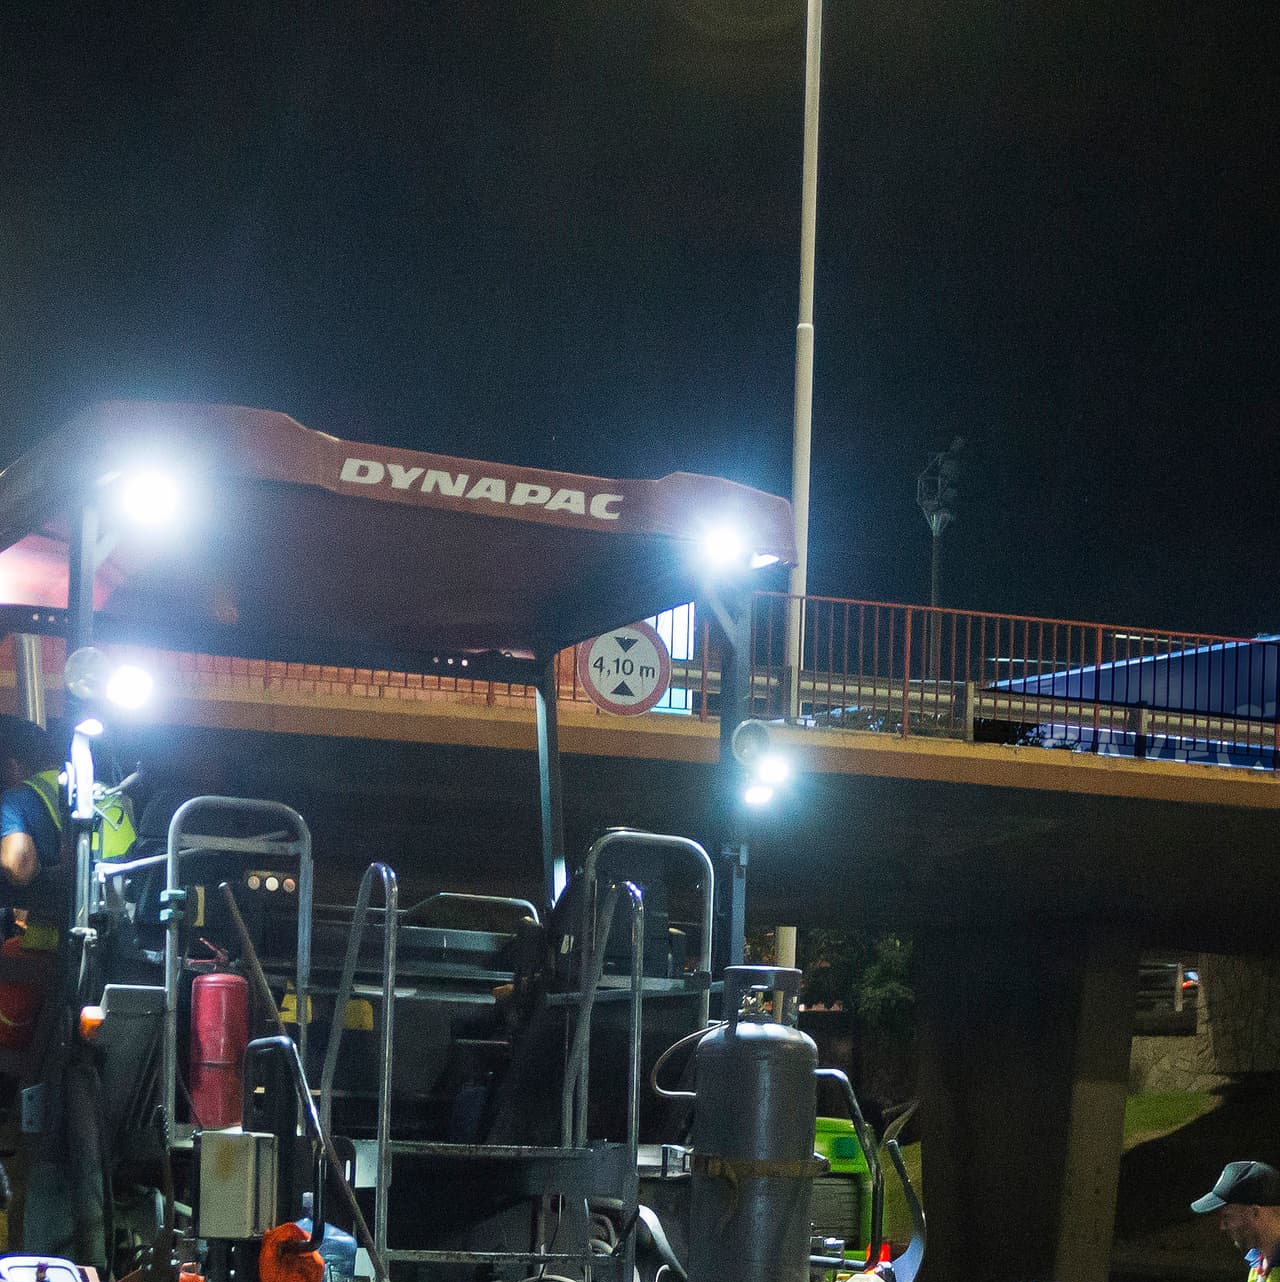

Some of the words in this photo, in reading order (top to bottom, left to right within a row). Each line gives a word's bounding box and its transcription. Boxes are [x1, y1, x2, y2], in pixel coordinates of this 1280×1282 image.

[339, 457, 624, 520] DYNAPAC
[592, 656, 634, 676] 4,10
[639, 665, 655, 679] m
